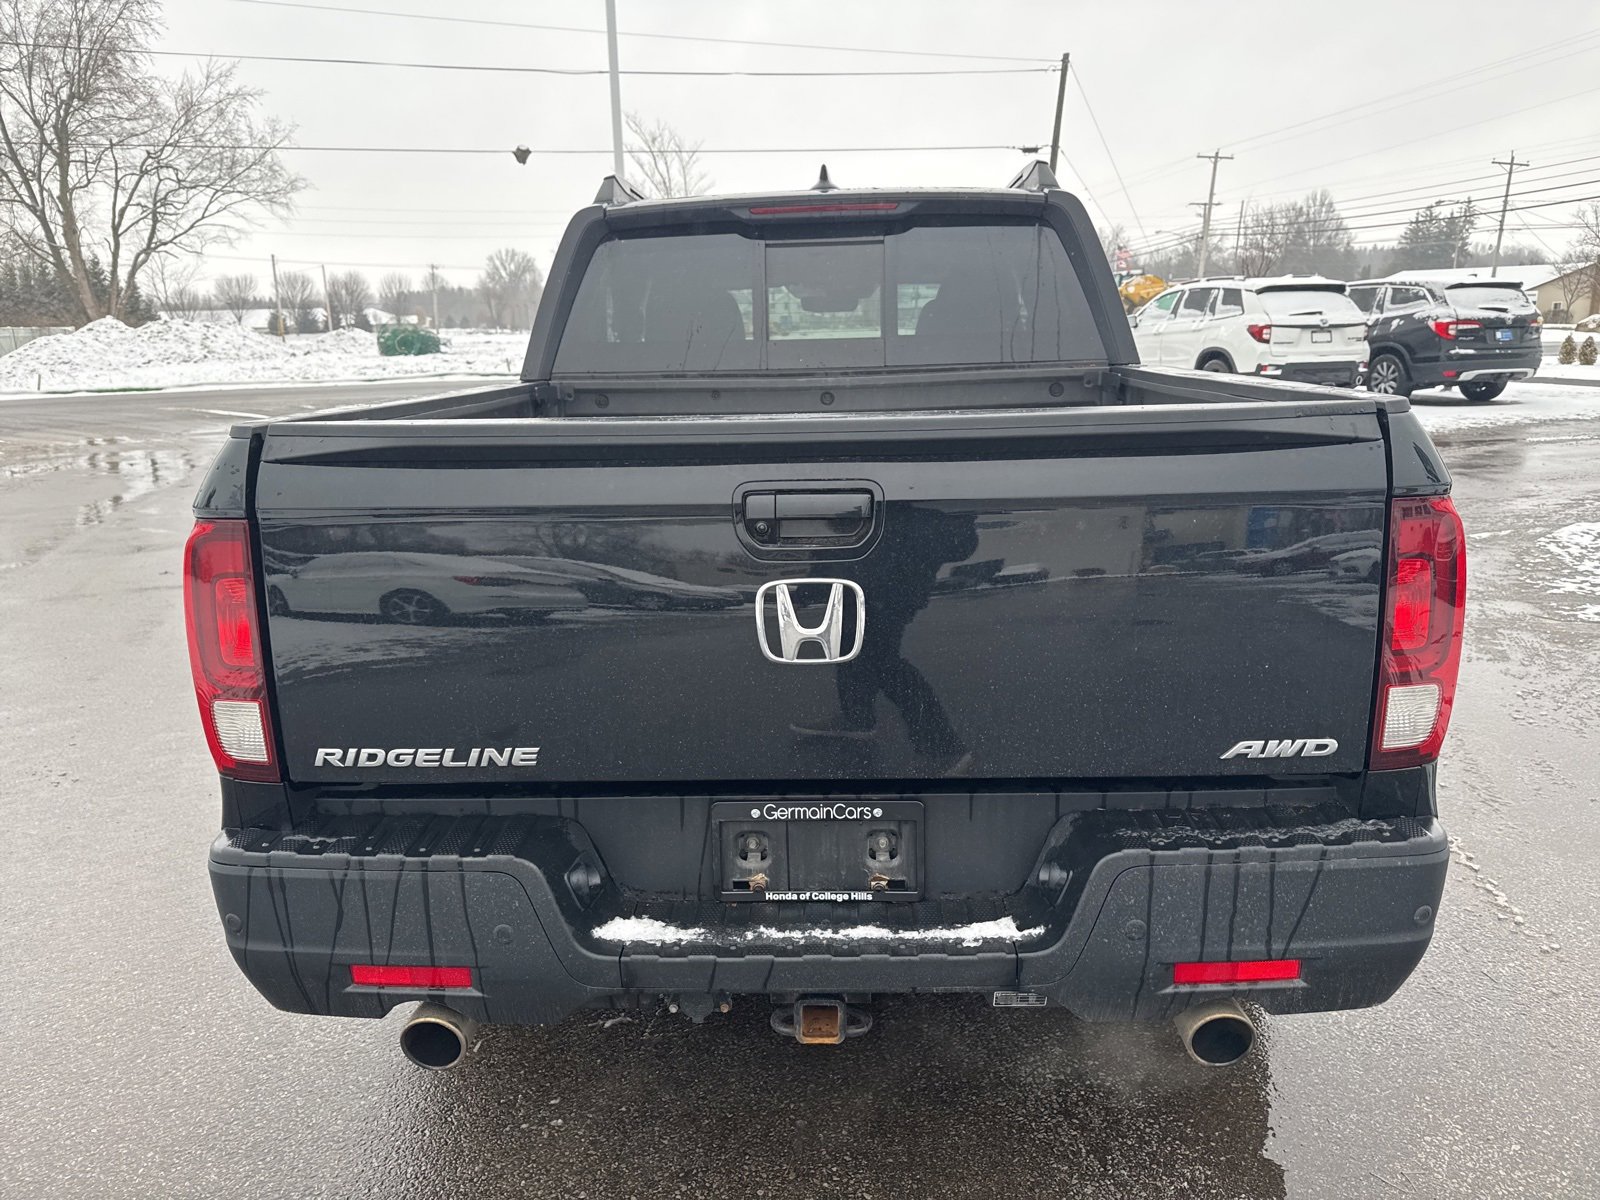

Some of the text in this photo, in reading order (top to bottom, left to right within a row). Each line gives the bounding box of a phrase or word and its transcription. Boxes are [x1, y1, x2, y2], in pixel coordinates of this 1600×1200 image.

[314, 747, 540, 767] RIDGELINE
[1219, 738, 1339, 759] AWD
[763, 803, 872, 820] GermainCars
[765, 892, 873, 902] Honda of College Hills
